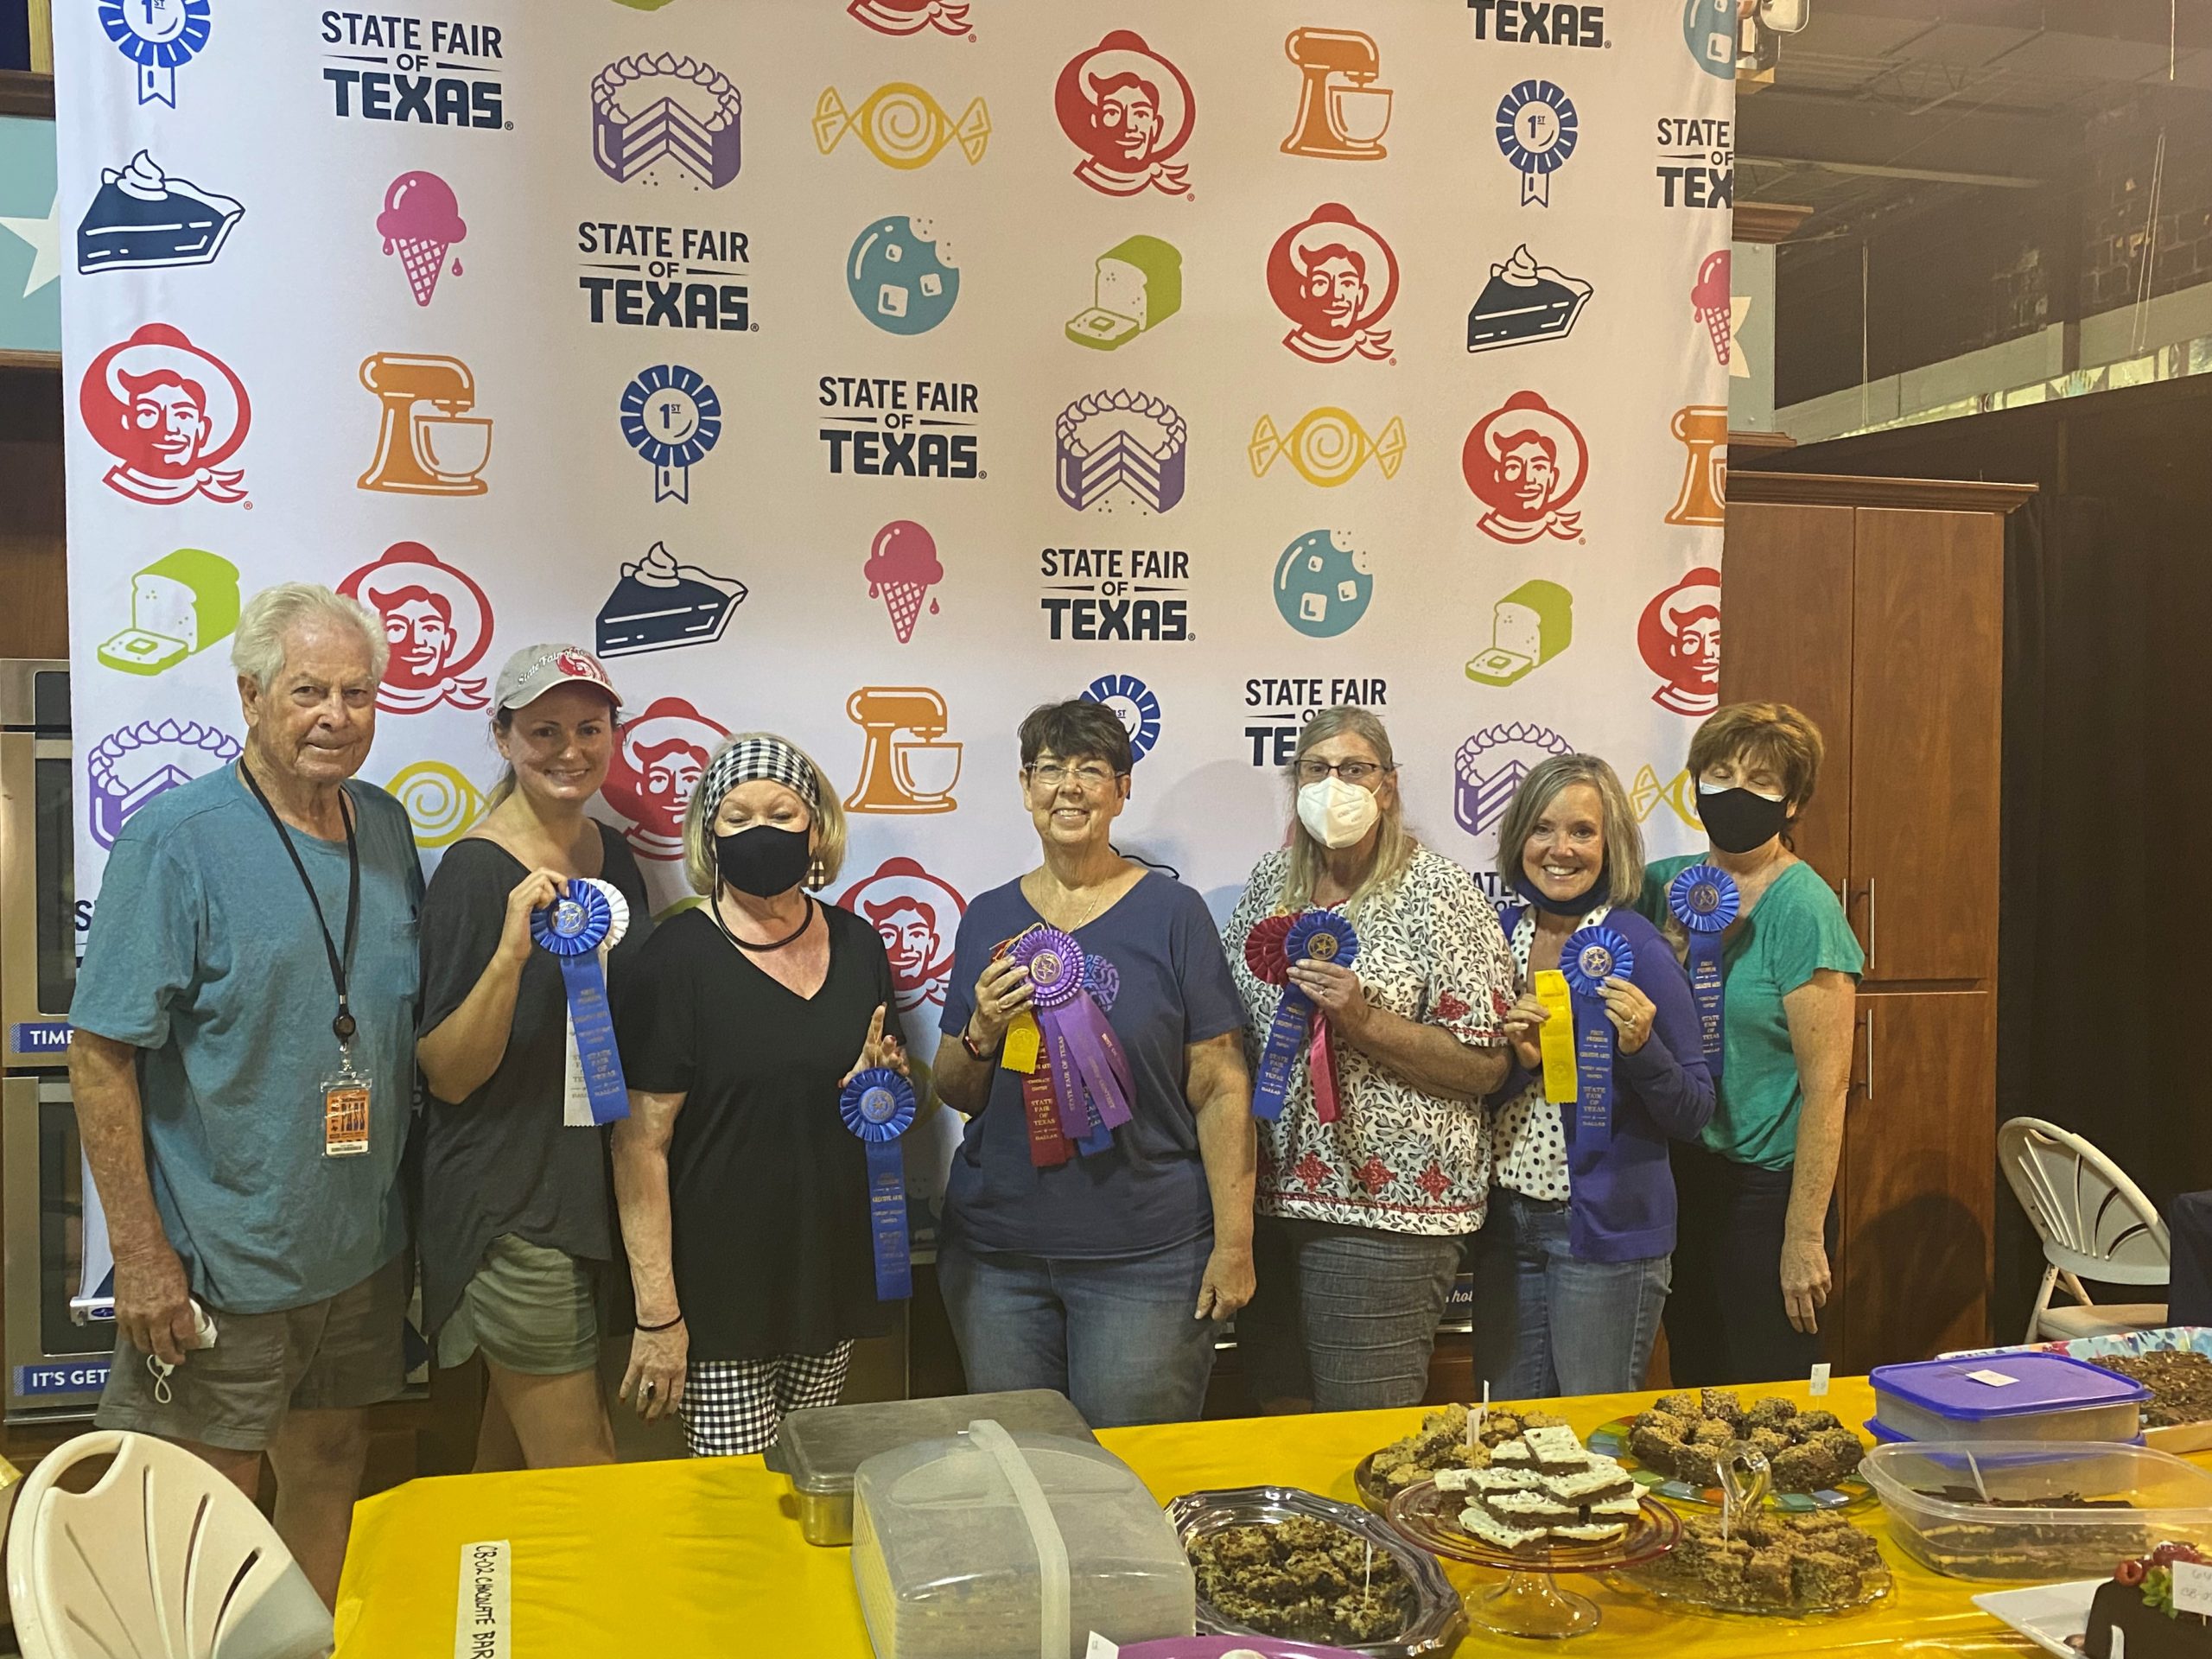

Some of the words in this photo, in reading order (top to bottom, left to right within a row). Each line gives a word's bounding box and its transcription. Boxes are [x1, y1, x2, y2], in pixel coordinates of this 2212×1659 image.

[321, 10, 421, 50] STATE
[432, 21, 503, 59] FAIR
[1467, 0, 1604, 48] TEXAS
[397, 54, 429, 72] OF
[323, 68, 503, 130] TEXAS
[1657, 118, 1730, 148] STATE
[1711, 151, 1733, 166] OF
[1656, 167, 1733, 209] TEX
[578, 221, 672, 258] STATE
[683, 228, 749, 263] FAIR
[648, 261, 679, 277] OF
[580, 276, 748, 332] TEXAS
[819, 376, 907, 410] STATE
[917, 382, 979, 413] FAIR
[885, 413, 913, 429] OF
[820, 429, 977, 479] TEXAS
[1041, 548, 1122, 578] STATE
[1131, 550, 1189, 578] FAIR
[1102, 581, 1128, 596] OF
[1041, 598, 1187, 640] TEXAS
[518, 664, 539, 687] State
[1245, 679, 1323, 706] STATE
[1332, 679, 1387, 705] FAIR
[33, 1371, 65, 1388] IT'S
[70, 1369, 111, 1384] GET
